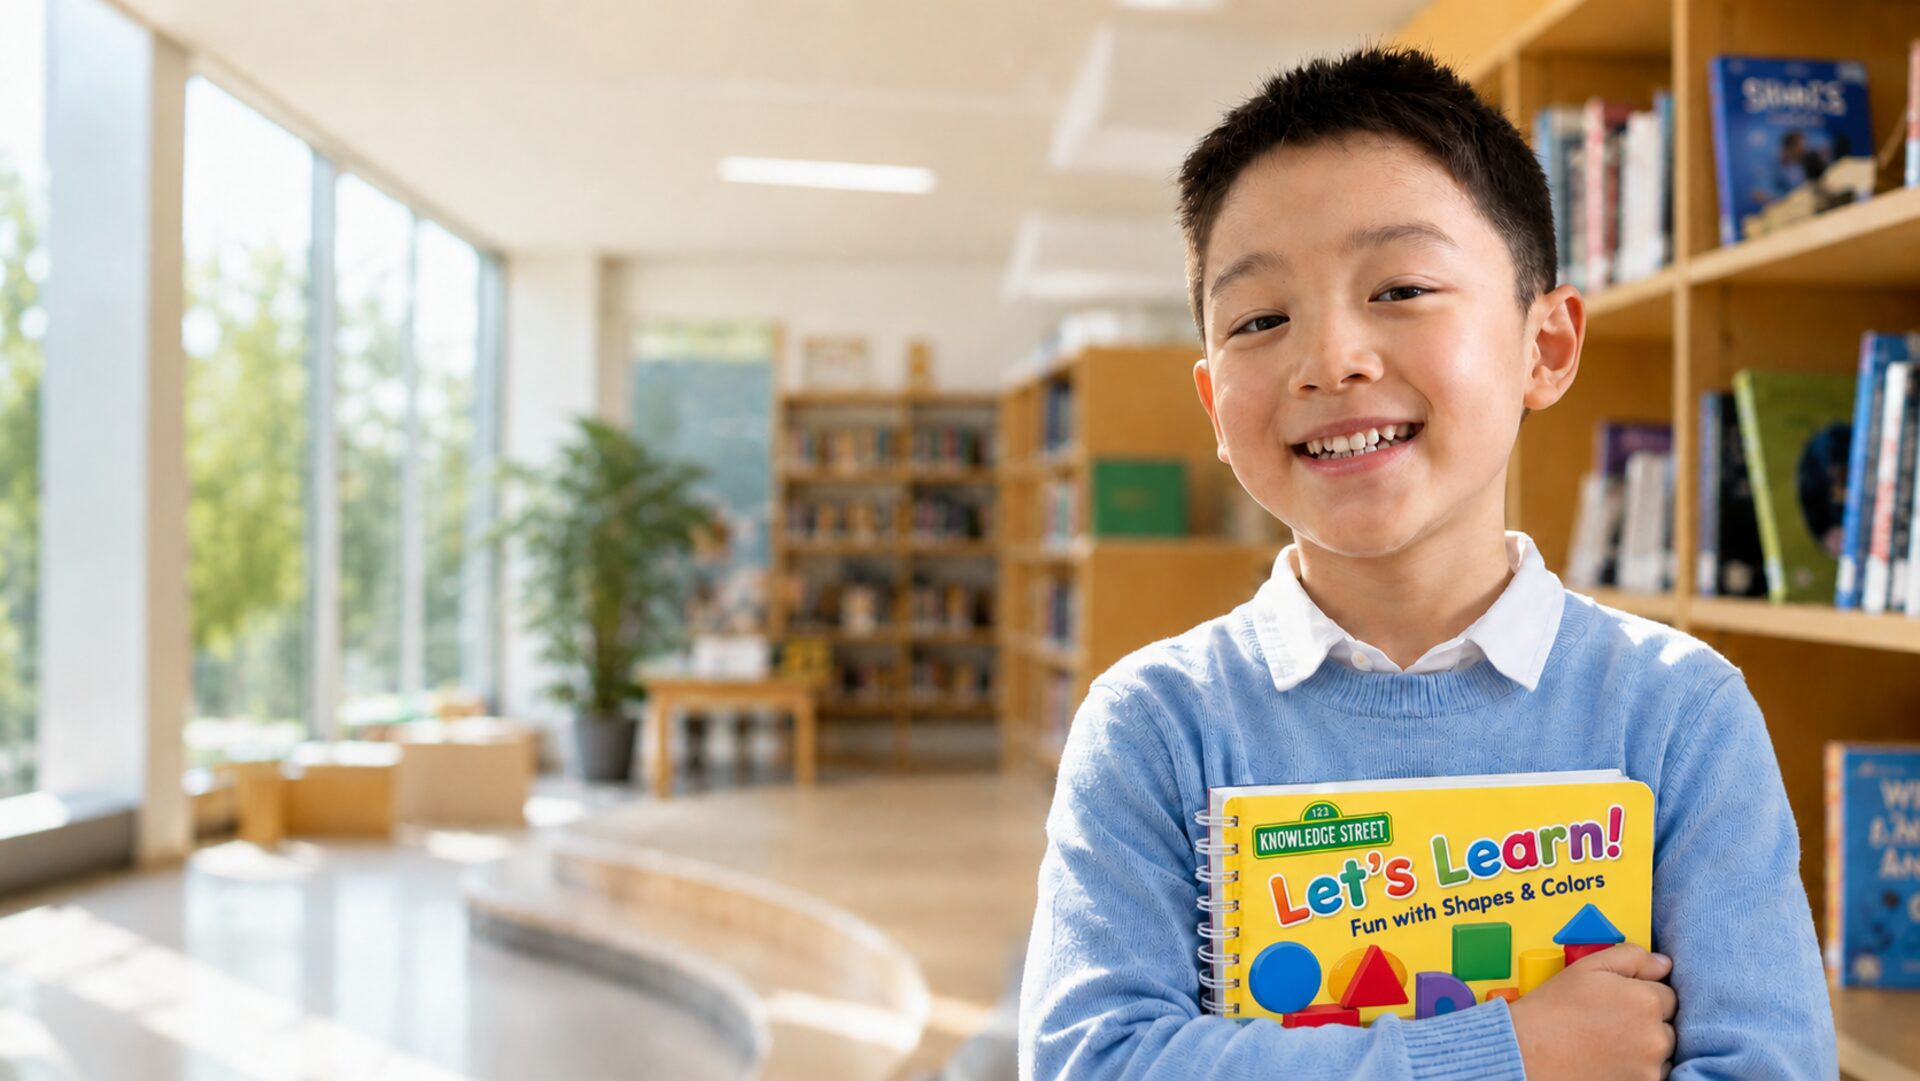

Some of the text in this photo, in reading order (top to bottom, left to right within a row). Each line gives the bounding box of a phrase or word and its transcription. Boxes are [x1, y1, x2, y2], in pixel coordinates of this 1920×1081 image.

[1311, 806, 1330, 818] 123
[1259, 825, 1337, 851] KNOWLEDGE
[1270, 805, 1624, 926] Let's Learn!
[1350, 874, 1606, 938] Fun with Shapes & Colors
